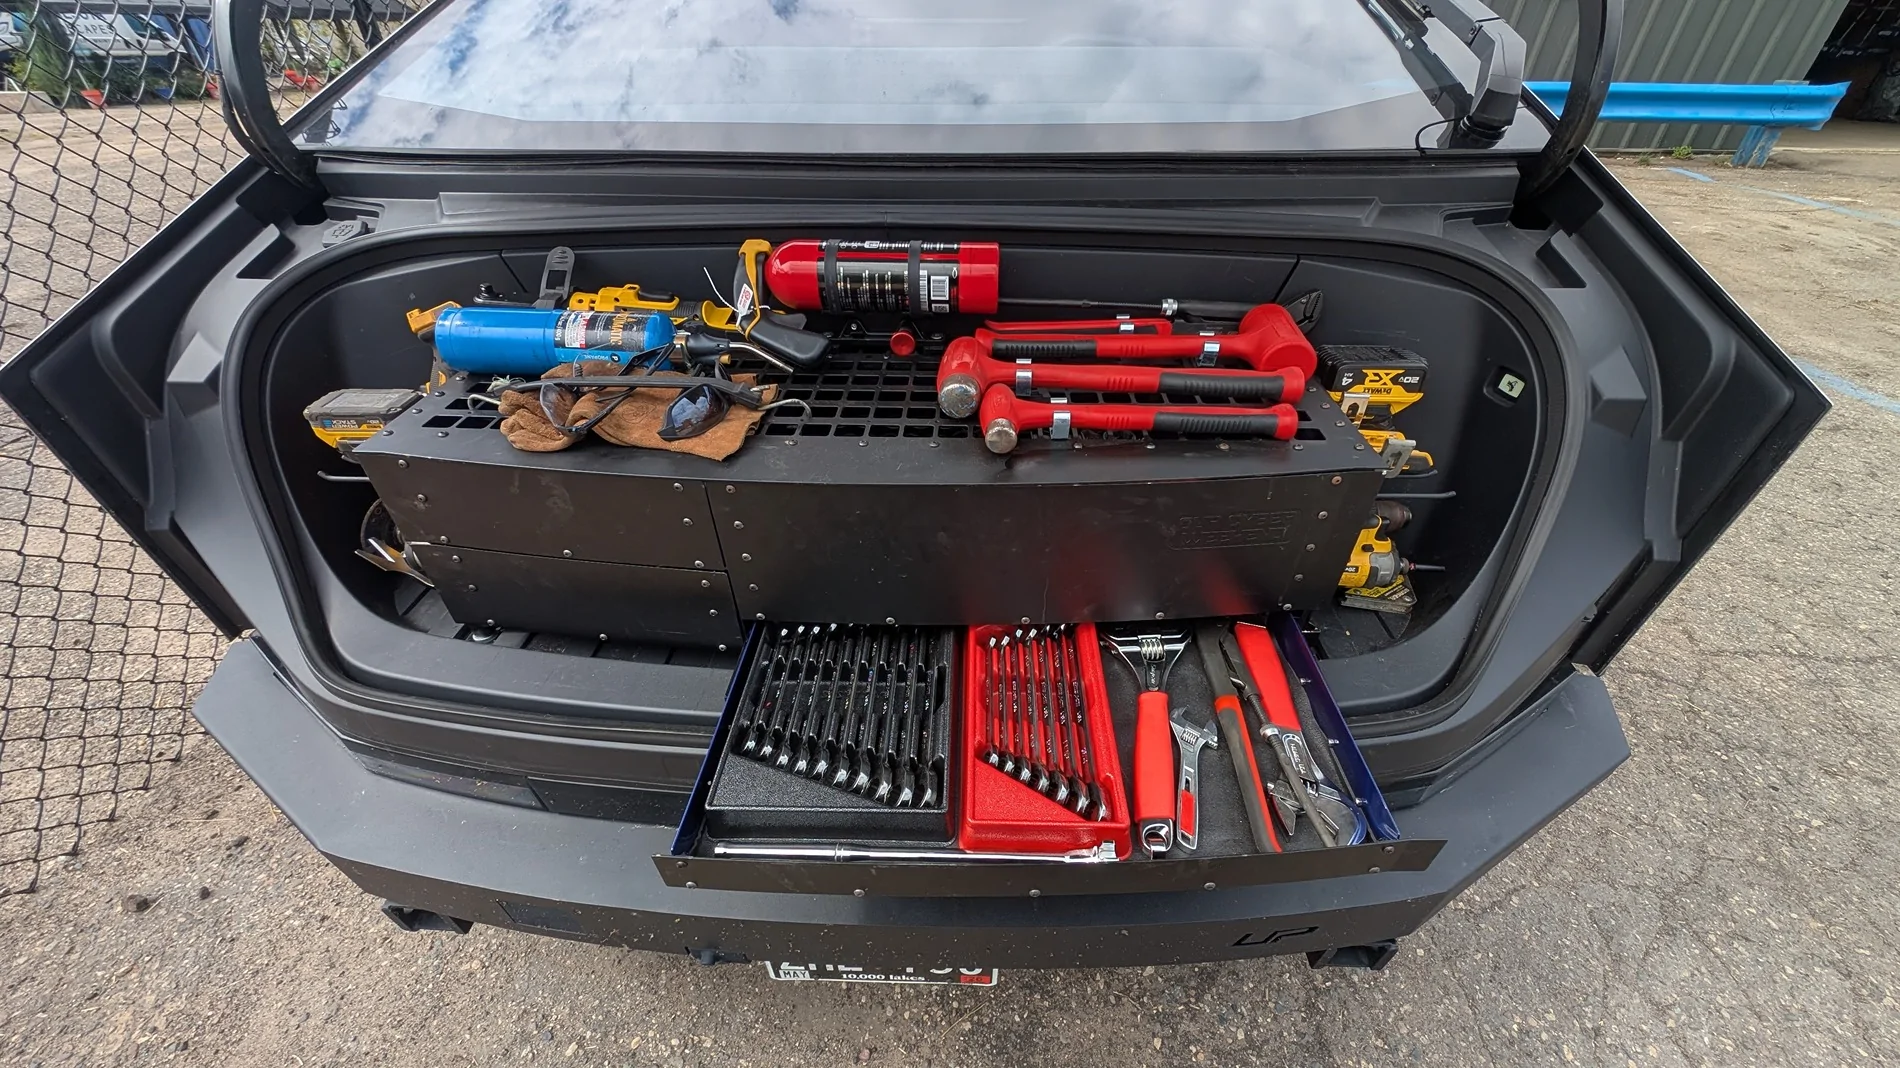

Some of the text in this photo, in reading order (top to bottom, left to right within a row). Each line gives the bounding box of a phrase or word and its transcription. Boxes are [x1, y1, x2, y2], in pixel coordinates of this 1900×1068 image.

[1341, 377, 1353, 386] 4
[1362, 369, 1405, 386] XR
[783, 970, 807, 979] MAY
